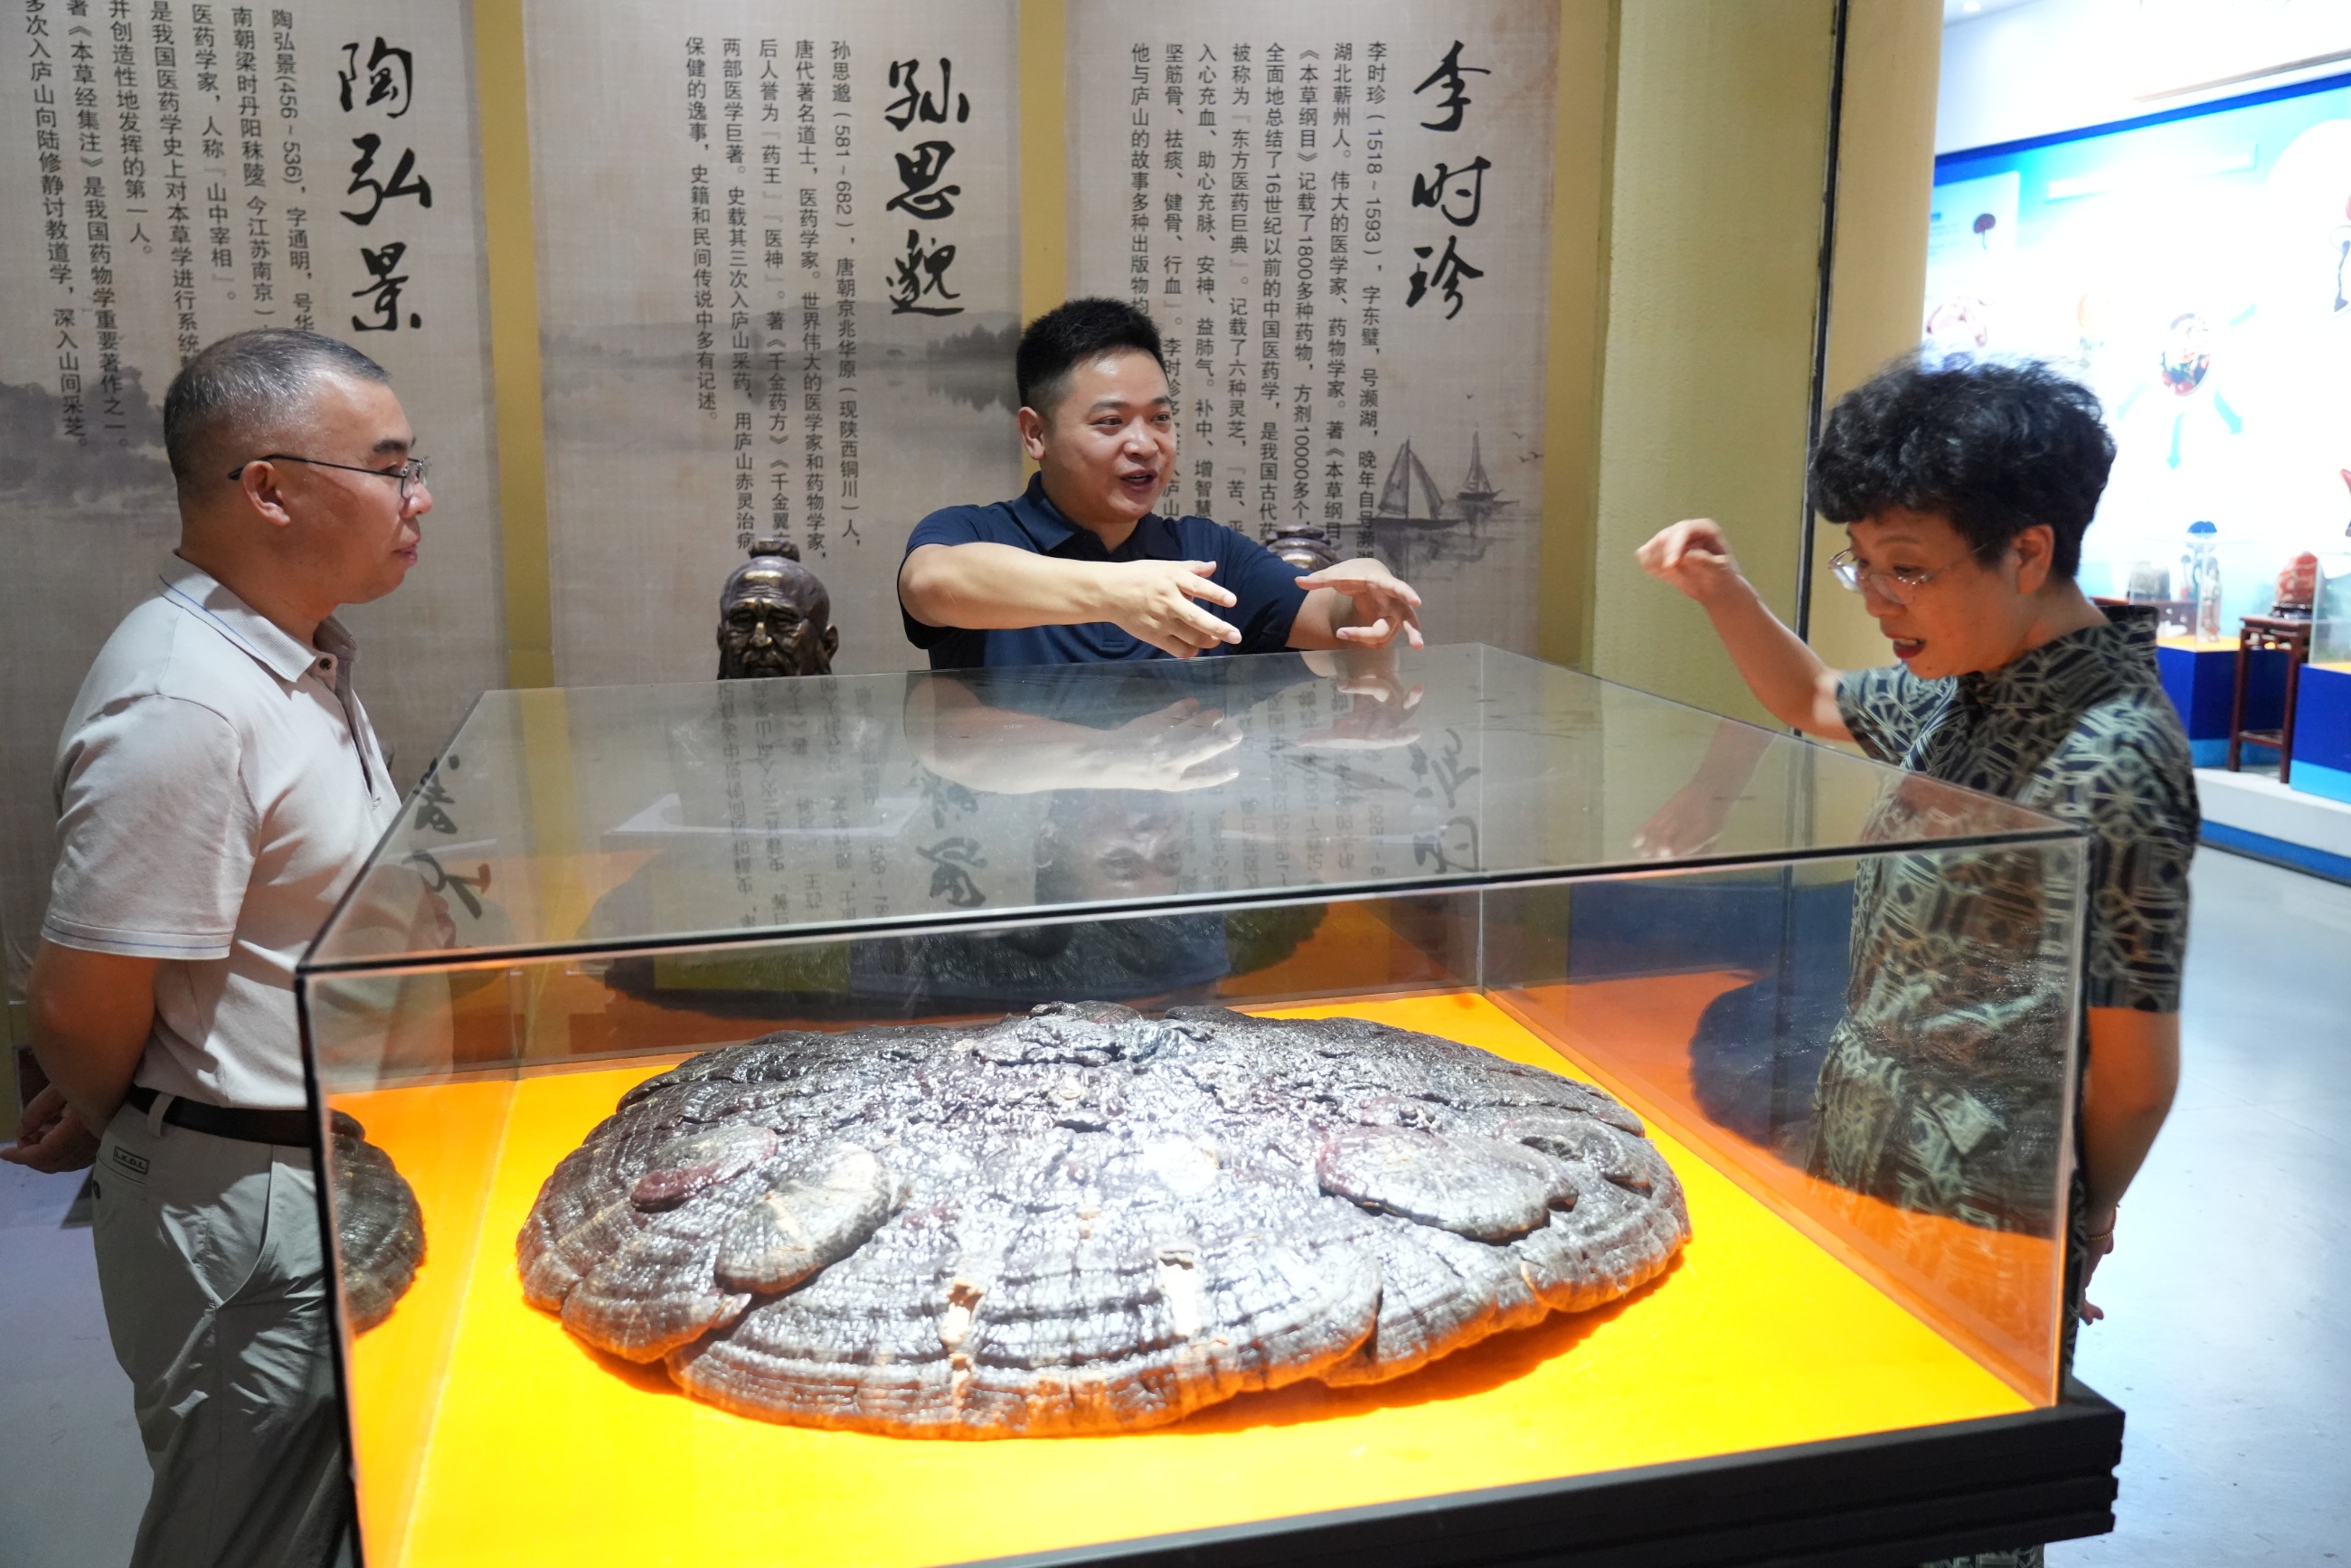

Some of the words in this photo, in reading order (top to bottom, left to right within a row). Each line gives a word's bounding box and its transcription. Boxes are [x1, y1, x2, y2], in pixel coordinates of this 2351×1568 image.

[151, 0, 200, 364] 是我国医药学史上对本草学进行系统
[338, 36, 432, 333] 陶弘景
[884, 57, 970, 316] 孙思邈
[1405, 40, 1492, 320] 李时珍
